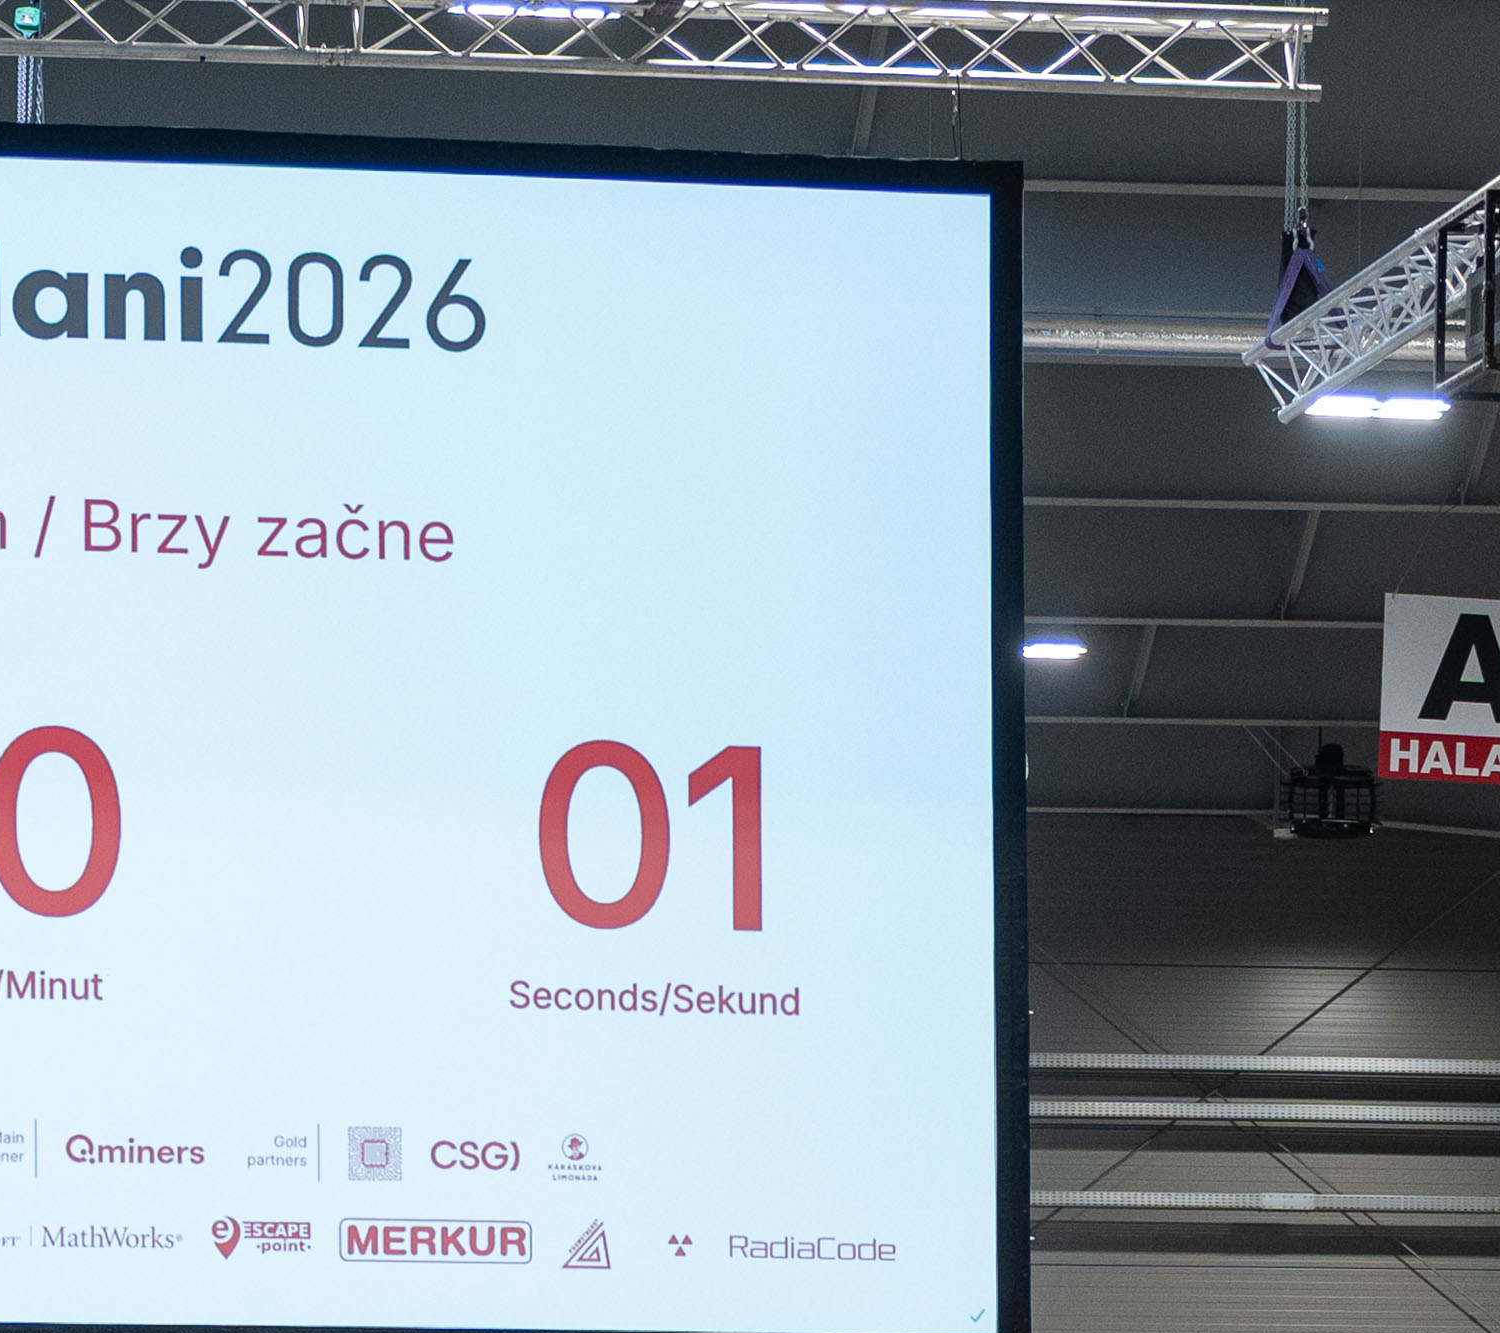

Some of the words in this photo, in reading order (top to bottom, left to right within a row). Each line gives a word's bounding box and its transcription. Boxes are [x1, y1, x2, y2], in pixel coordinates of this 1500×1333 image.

[35, 496, 55, 558] /
[84, 499, 230, 569] Brzy
[257, 504, 453, 562] začne
[539, 740, 762, 931] 01
[510, 980, 799, 1016] Seconds/Sekund
[274, 1135, 308, 1149] Gold
[248, 1155, 308, 1168] partners
[244, 1223, 310, 1238] ESCAPE
[347, 1225, 526, 1256] MERKUR
[729, 1235, 897, 1261] RadiaCode
